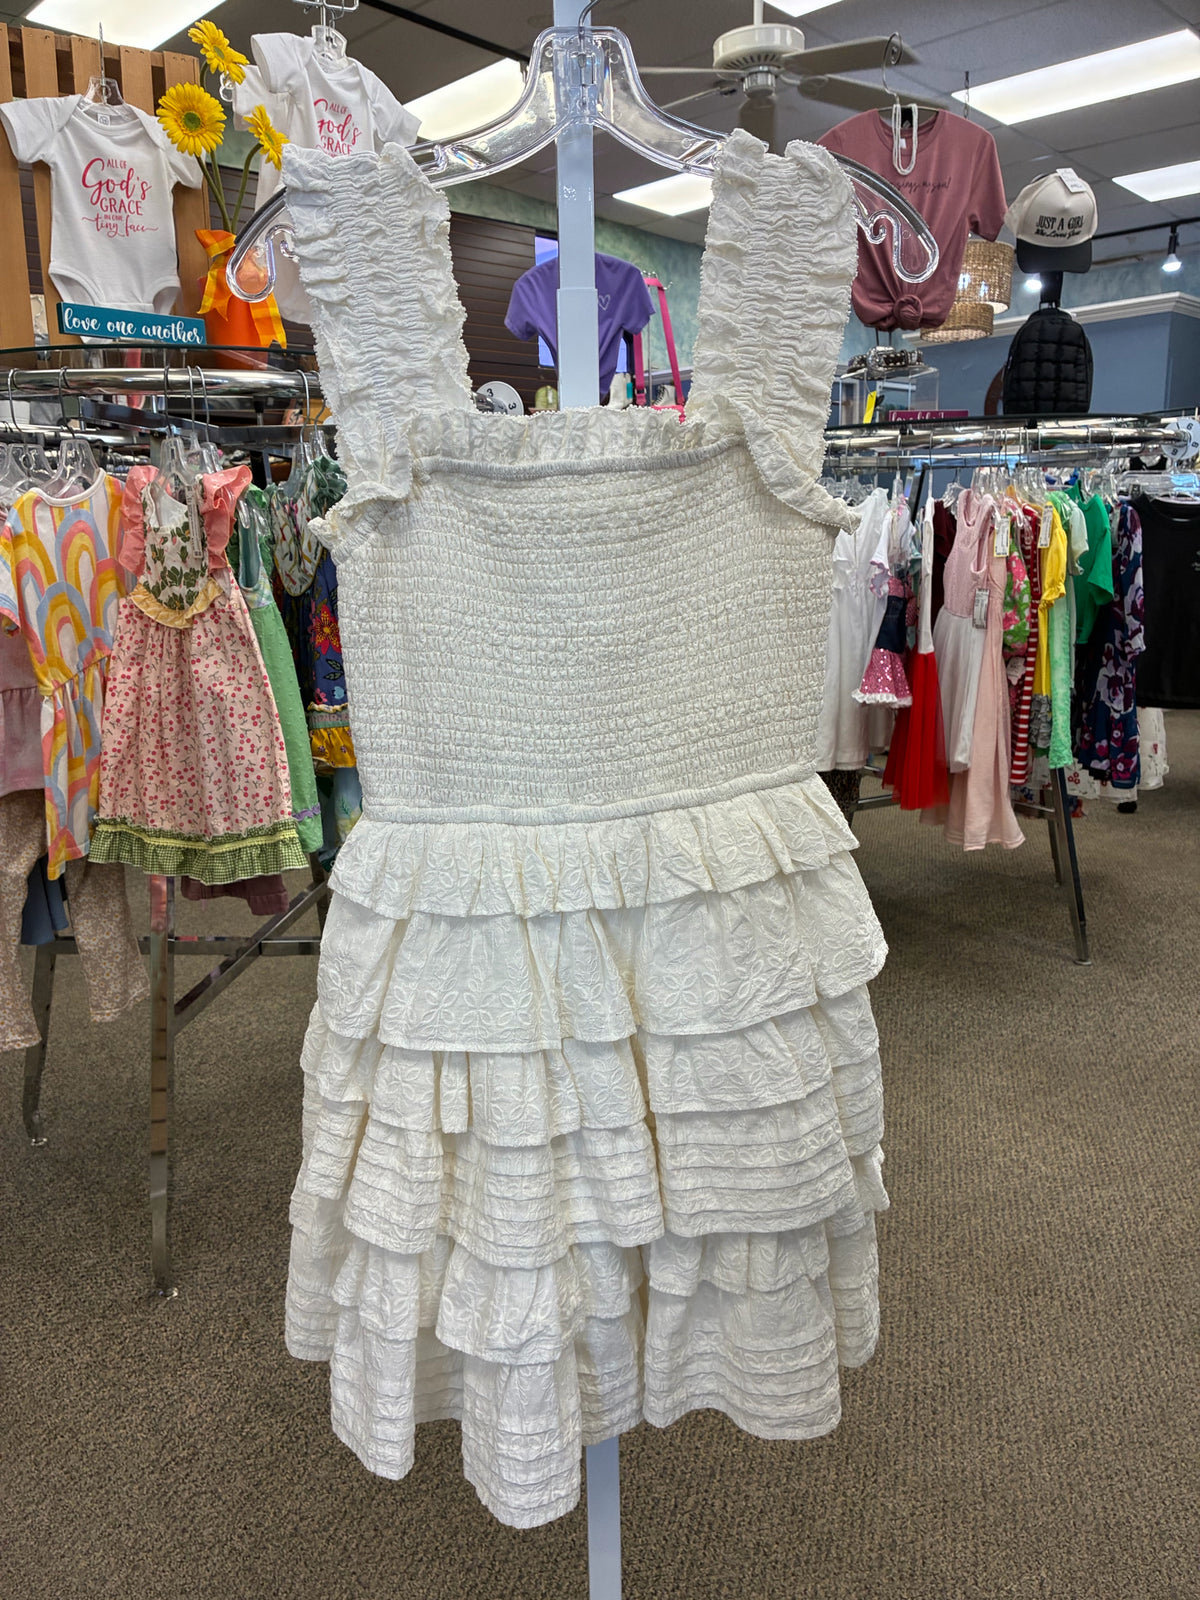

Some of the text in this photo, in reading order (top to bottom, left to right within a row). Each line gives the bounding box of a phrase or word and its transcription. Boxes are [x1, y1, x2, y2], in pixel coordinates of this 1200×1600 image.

[106, 158, 119, 169] ALL
[81, 157, 152, 206] God's
[100, 197, 144, 216] GRACE
[82, 213, 159, 238] tiny face
[1036, 215, 1084, 230] JUST A GIRL
[64, 307, 204, 344] love one another
[486, 388, 494, 397] 3
